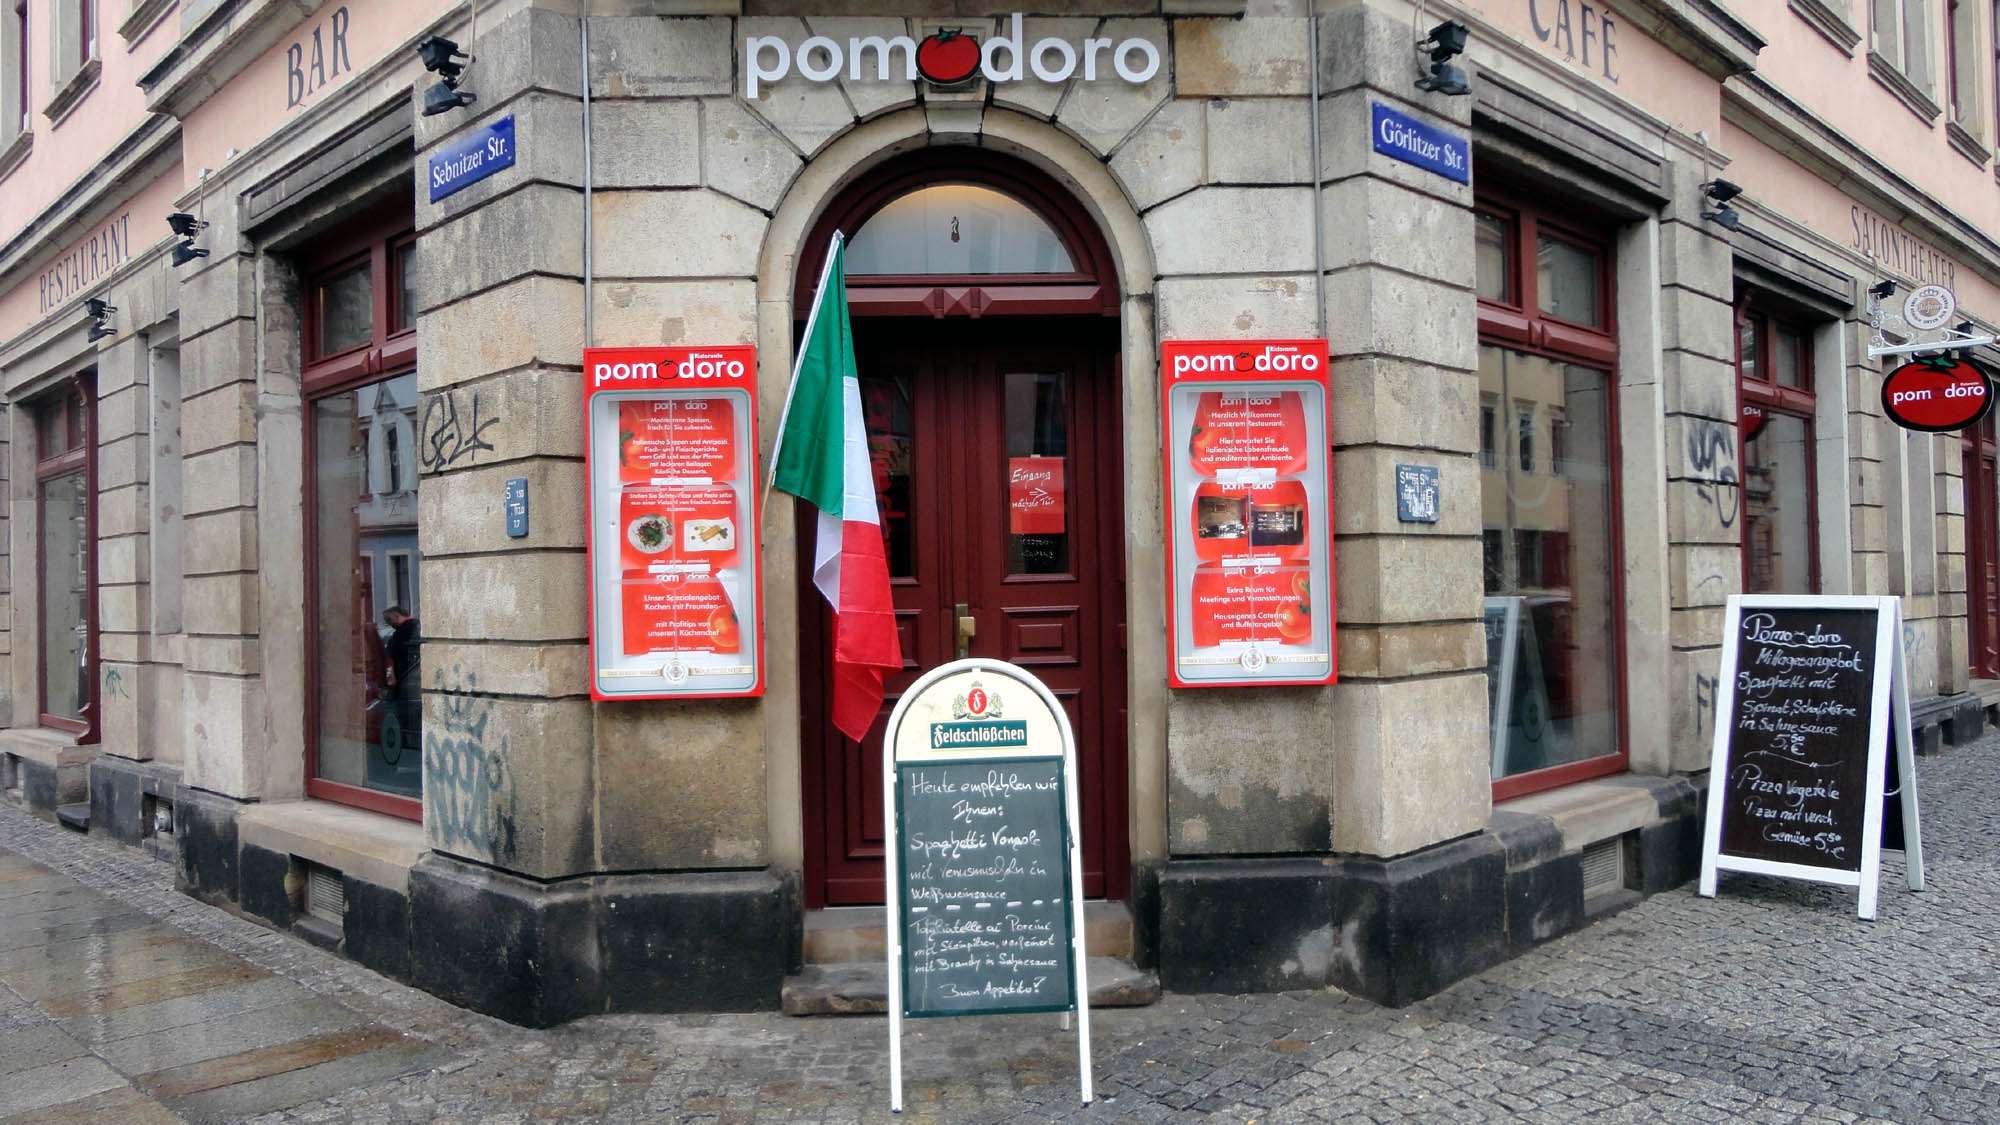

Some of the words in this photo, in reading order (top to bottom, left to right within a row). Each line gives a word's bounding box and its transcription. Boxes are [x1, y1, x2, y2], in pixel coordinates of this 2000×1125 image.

[1529, 0, 1619, 84] CAFÉ
[286, 5, 352, 111] BAR
[1380, 117, 1440, 161] Görlitzer
[1444, 143, 1466, 171] Str.
[432, 149, 484, 189] Sebnitzer
[486, 133, 509, 163] Str.
[1849, 205, 1956, 292] SALONTHEATER
[38, 211, 132, 314] RESTAURANT
[1010, 467, 1052, 490] Eingang
[1738, 671, 1806, 699] Spaghetti
[1808, 672, 1839, 690] mit
[1738, 714, 1756, 731] in
[911, 770, 956, 797] Heute
[960, 769, 1032, 798] empfehlen
[1035, 776, 1059, 791] wir
[1731, 763, 1783, 793] Pizza
[951, 799, 1004, 824] Ihnen:
[1743, 795, 1778, 815] Pizza
[1780, 803, 1805, 821] mit
[910, 830, 987, 859] Spaghetti
[991, 825, 1041, 852] Vongole
[1762, 822, 1812, 847] Gemüse
[910, 861, 934, 881] mit
[1029, 860, 1047, 876] in
[911, 887, 1008, 904] Weißweinsauce
[910, 914, 983, 941] Tagliatelle
[985, 921, 1003, 933] ai
[913, 942, 938, 957] mit
[914, 960, 937, 974] mit
[936, 954, 981, 972] Brandy
[938, 982, 981, 999] Buon
